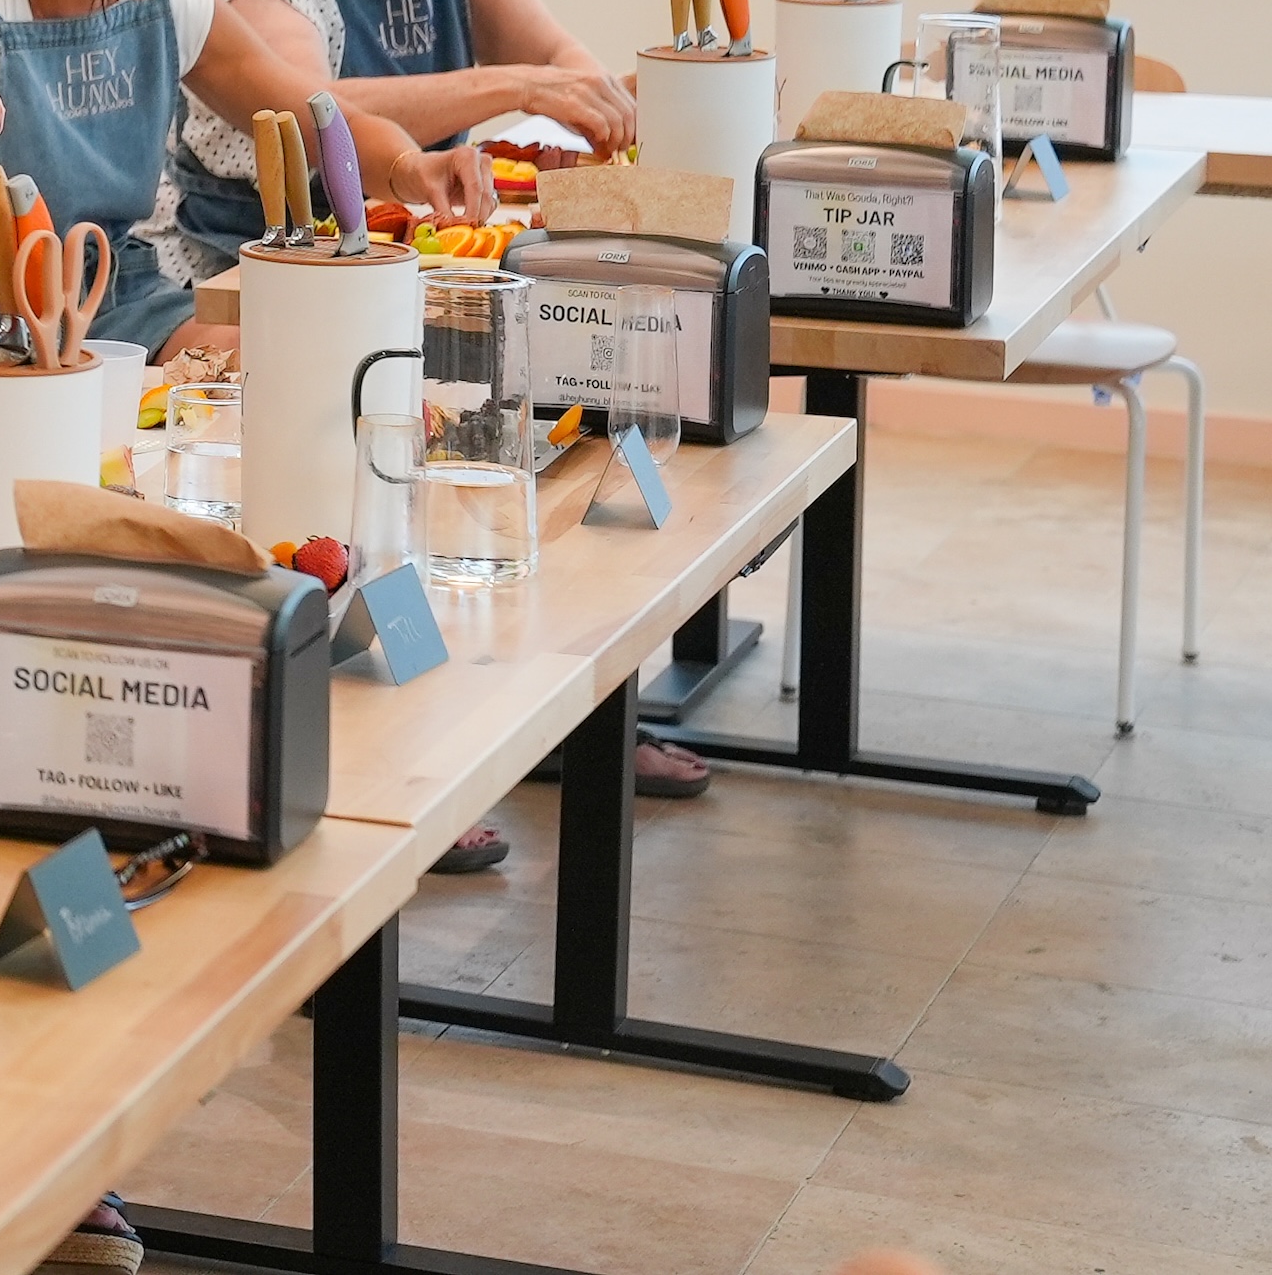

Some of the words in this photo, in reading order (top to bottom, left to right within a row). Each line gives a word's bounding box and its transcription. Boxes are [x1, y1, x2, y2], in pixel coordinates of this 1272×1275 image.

[65, 45, 119, 84] HEY
[1035, 67, 1085, 82] MEDIA
[45, 66, 137, 112] HUNNY
[805, 189, 824, 200] That
[826, 191, 846, 202] Was
[823, 207, 852, 224] TIP
[856, 210, 895, 227] JAR
[600, 252, 627, 262] TORK
[793, 261, 827, 272] VENMO
[889, 269, 925, 279] PAYPAL
[568, 289, 589, 298] SCAN
[589, 290, 600, 299] TO
[600, 291, 617, 301] FOLL
[832, 288, 857, 297] THANK
[539, 304, 613, 326] SOCIAL
[556, 376, 577, 387] TAG
[13, 666, 114, 702] SOCIAL
[121, 678, 210, 711] MEDIA
[37, 768, 67, 785] TAG
[78, 774, 140, 794] FOLLOW
[153, 782, 183, 800] LIKE
